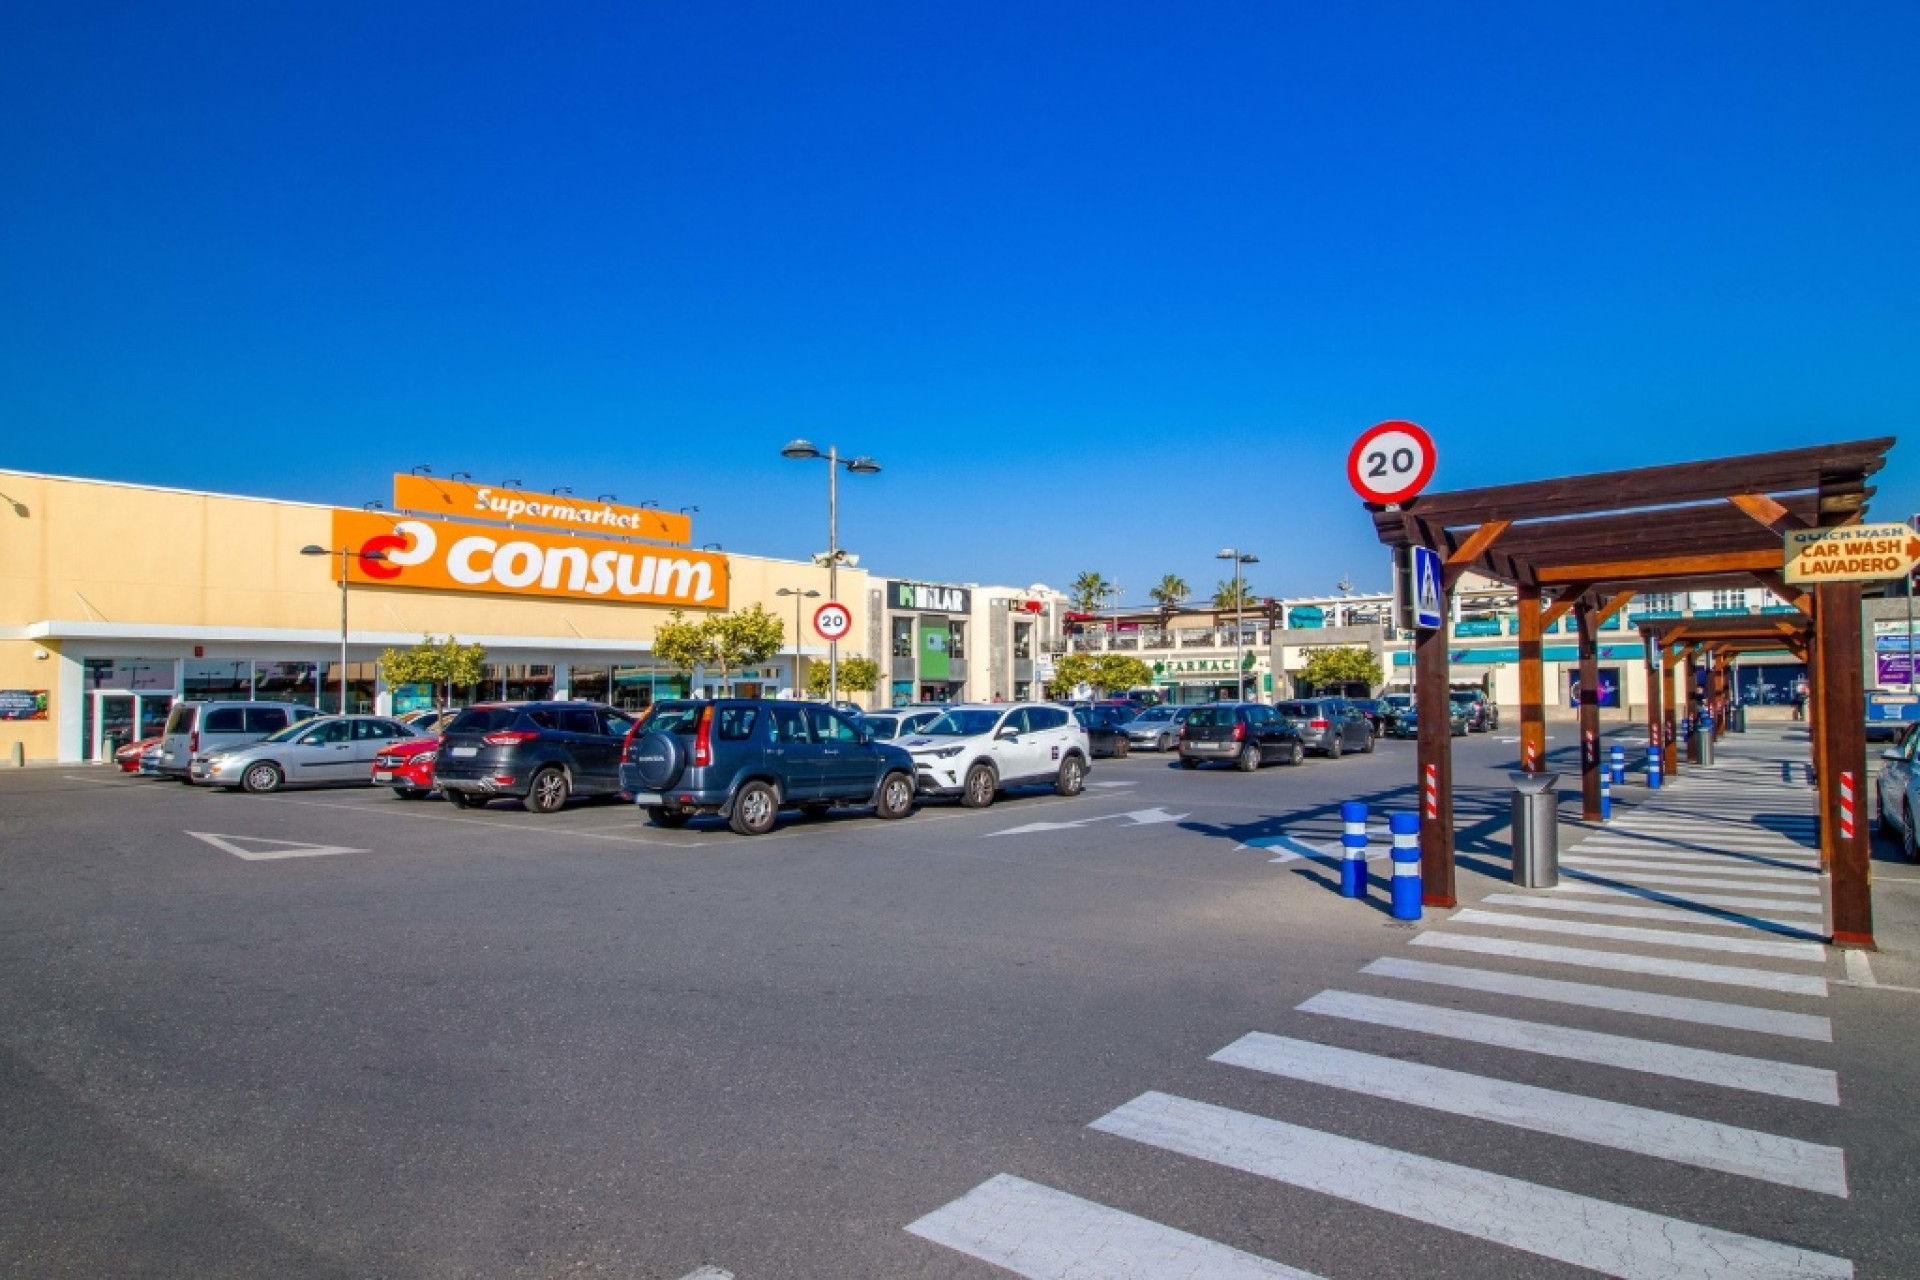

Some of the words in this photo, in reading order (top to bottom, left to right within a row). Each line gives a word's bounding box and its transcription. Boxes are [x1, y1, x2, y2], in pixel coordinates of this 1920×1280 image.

[1366, 447, 1415, 478] 20
[474, 488, 641, 529] Supermarket
[1801, 543, 1840, 558] CAR
[1844, 540, 1901, 556] WASH
[446, 535, 714, 602] consum
[1800, 556, 1900, 576] LAVADERO
[822, 614, 843, 628] 20
